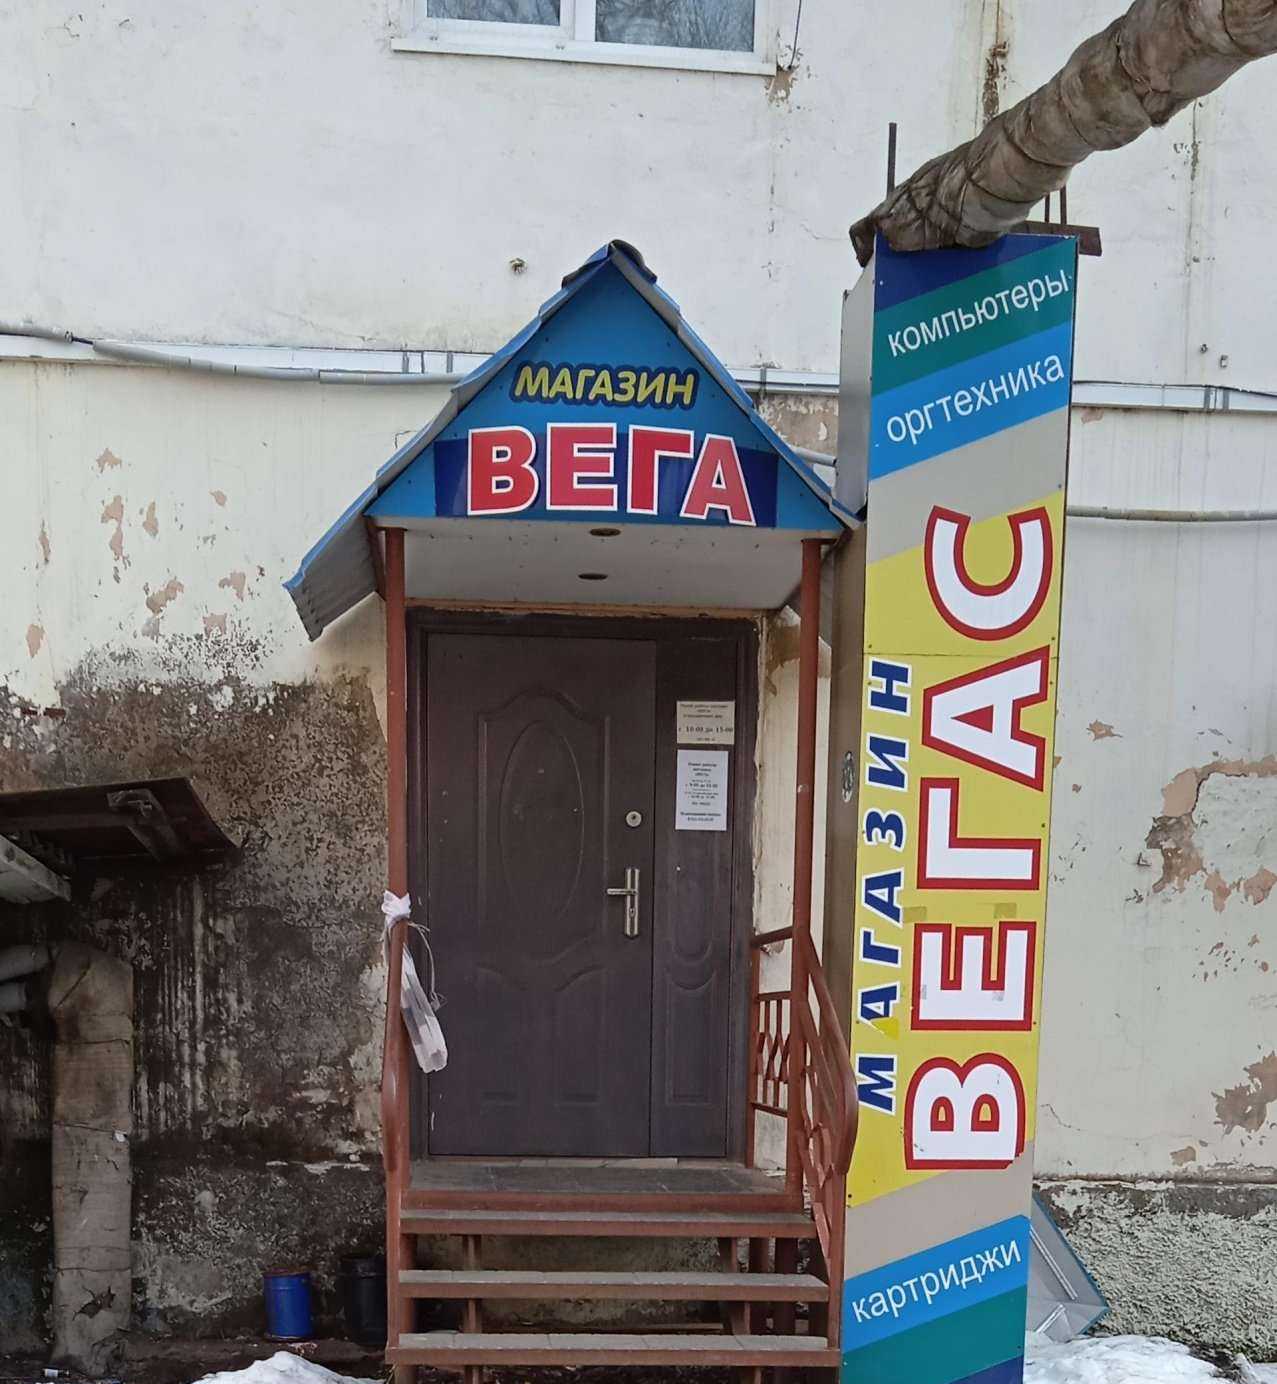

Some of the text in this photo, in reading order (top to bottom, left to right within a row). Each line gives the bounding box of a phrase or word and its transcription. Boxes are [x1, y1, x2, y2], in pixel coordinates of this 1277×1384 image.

[887, 268, 1070, 358] компьютеры
[512, 364, 697, 408] МАГАЗИН
[886, 354, 1065, 446] оргтехника
[466, 421, 757, 527] ВЕГА
[904, 504, 1057, 1171] ВЕГАС
[857, 656, 912, 1114] МАГАЗИН
[851, 1239, 1022, 1324] картриджи
